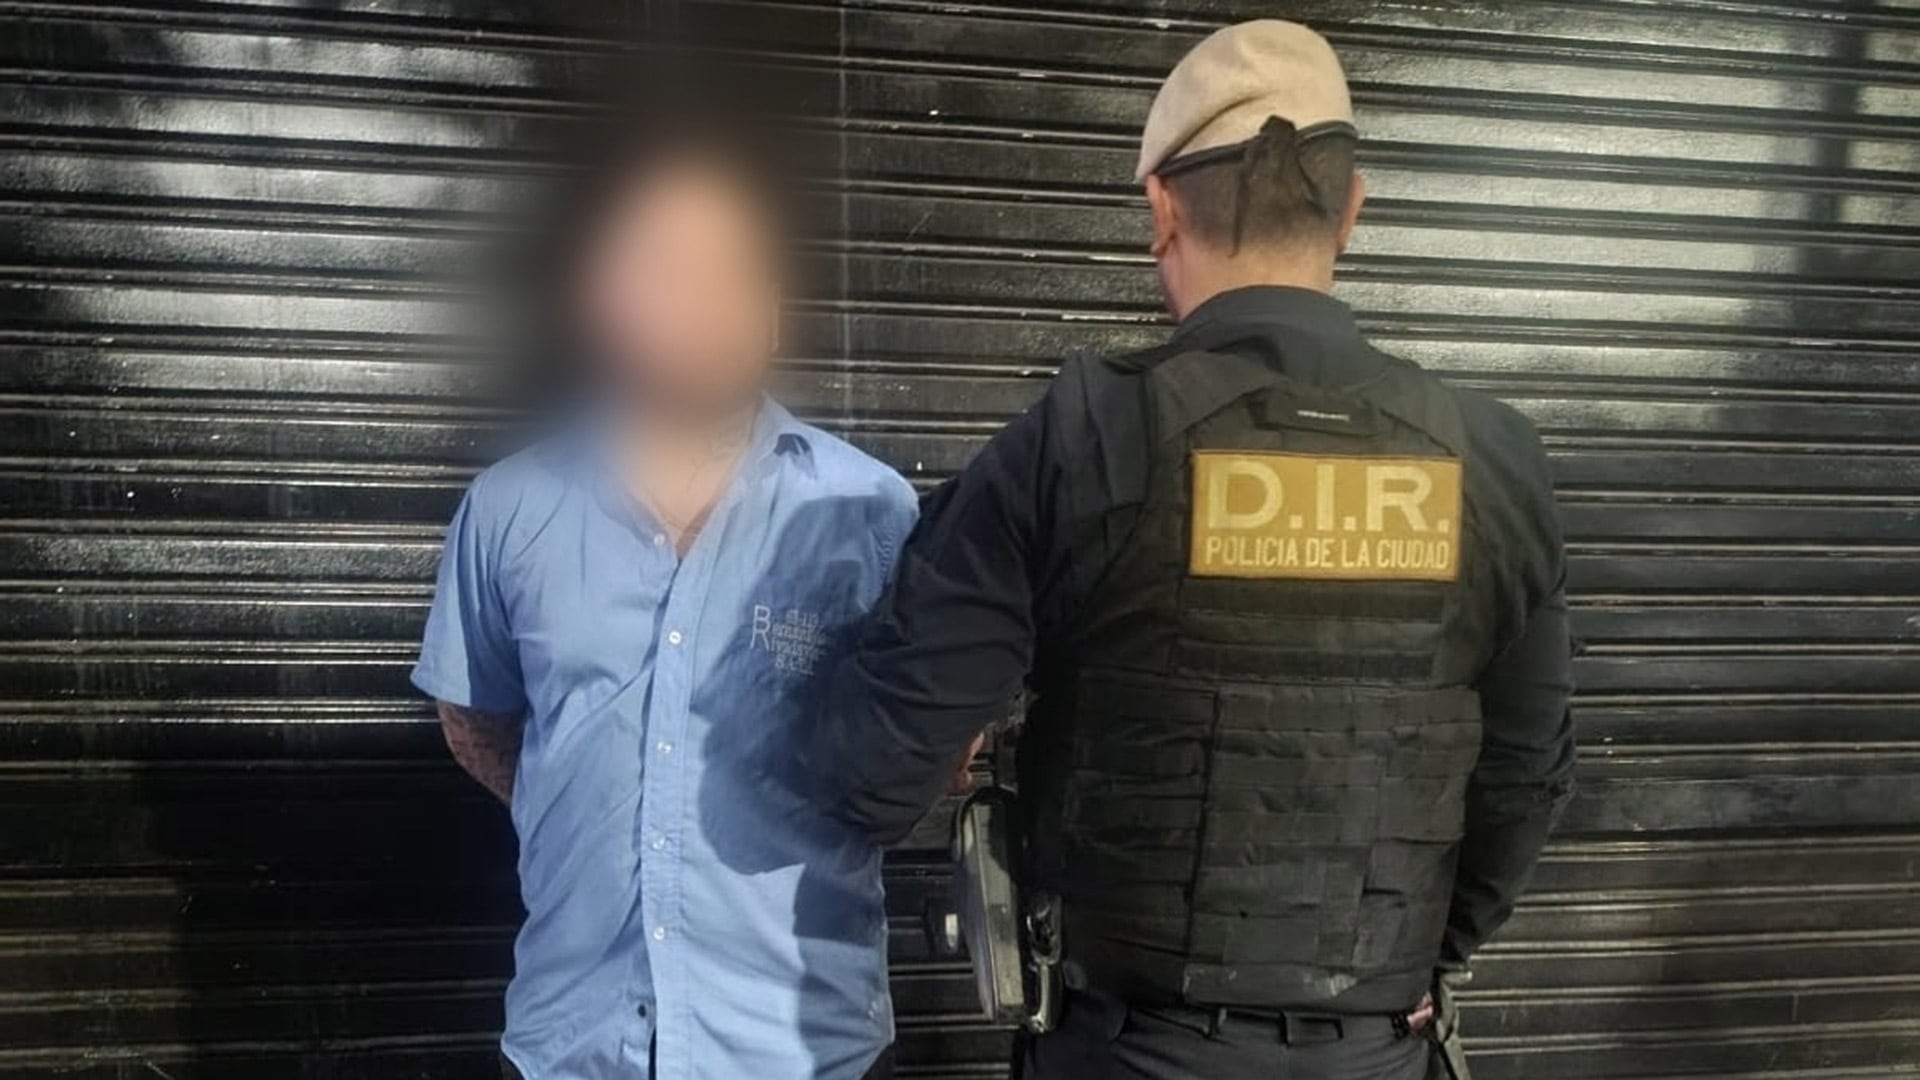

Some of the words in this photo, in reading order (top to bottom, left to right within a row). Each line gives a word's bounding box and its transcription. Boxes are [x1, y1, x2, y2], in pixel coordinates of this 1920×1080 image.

[1208, 460, 1450, 533] D.I.R.
[1205, 536, 1299, 566] POLICIA
[1305, 538, 1335, 568] DE
[1341, 539, 1370, 569] LA
[1376, 539, 1449, 569] CIUDAD
